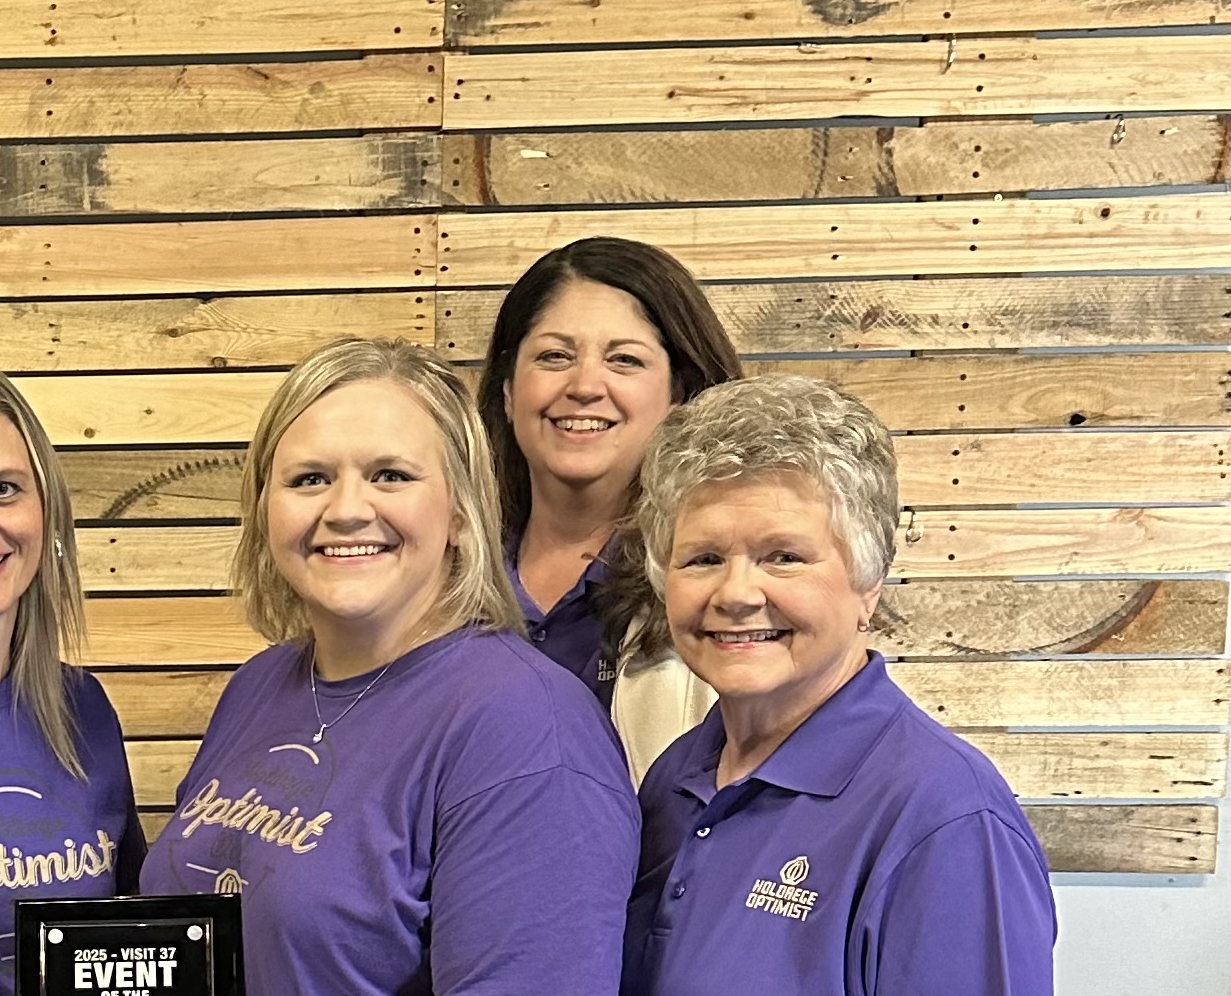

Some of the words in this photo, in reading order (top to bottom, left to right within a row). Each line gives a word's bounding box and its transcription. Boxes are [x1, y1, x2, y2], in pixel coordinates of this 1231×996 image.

[180, 778, 333, 854] Optimist
[745, 892, 812, 922] OPTIMIST
[752, 879, 819, 906] HOLDREGE
[74, 949, 108, 962] 2025
[120, 947, 157, 961] VISIT
[159, 947, 177, 960] 37
[74, 960, 178, 989] EVENT
